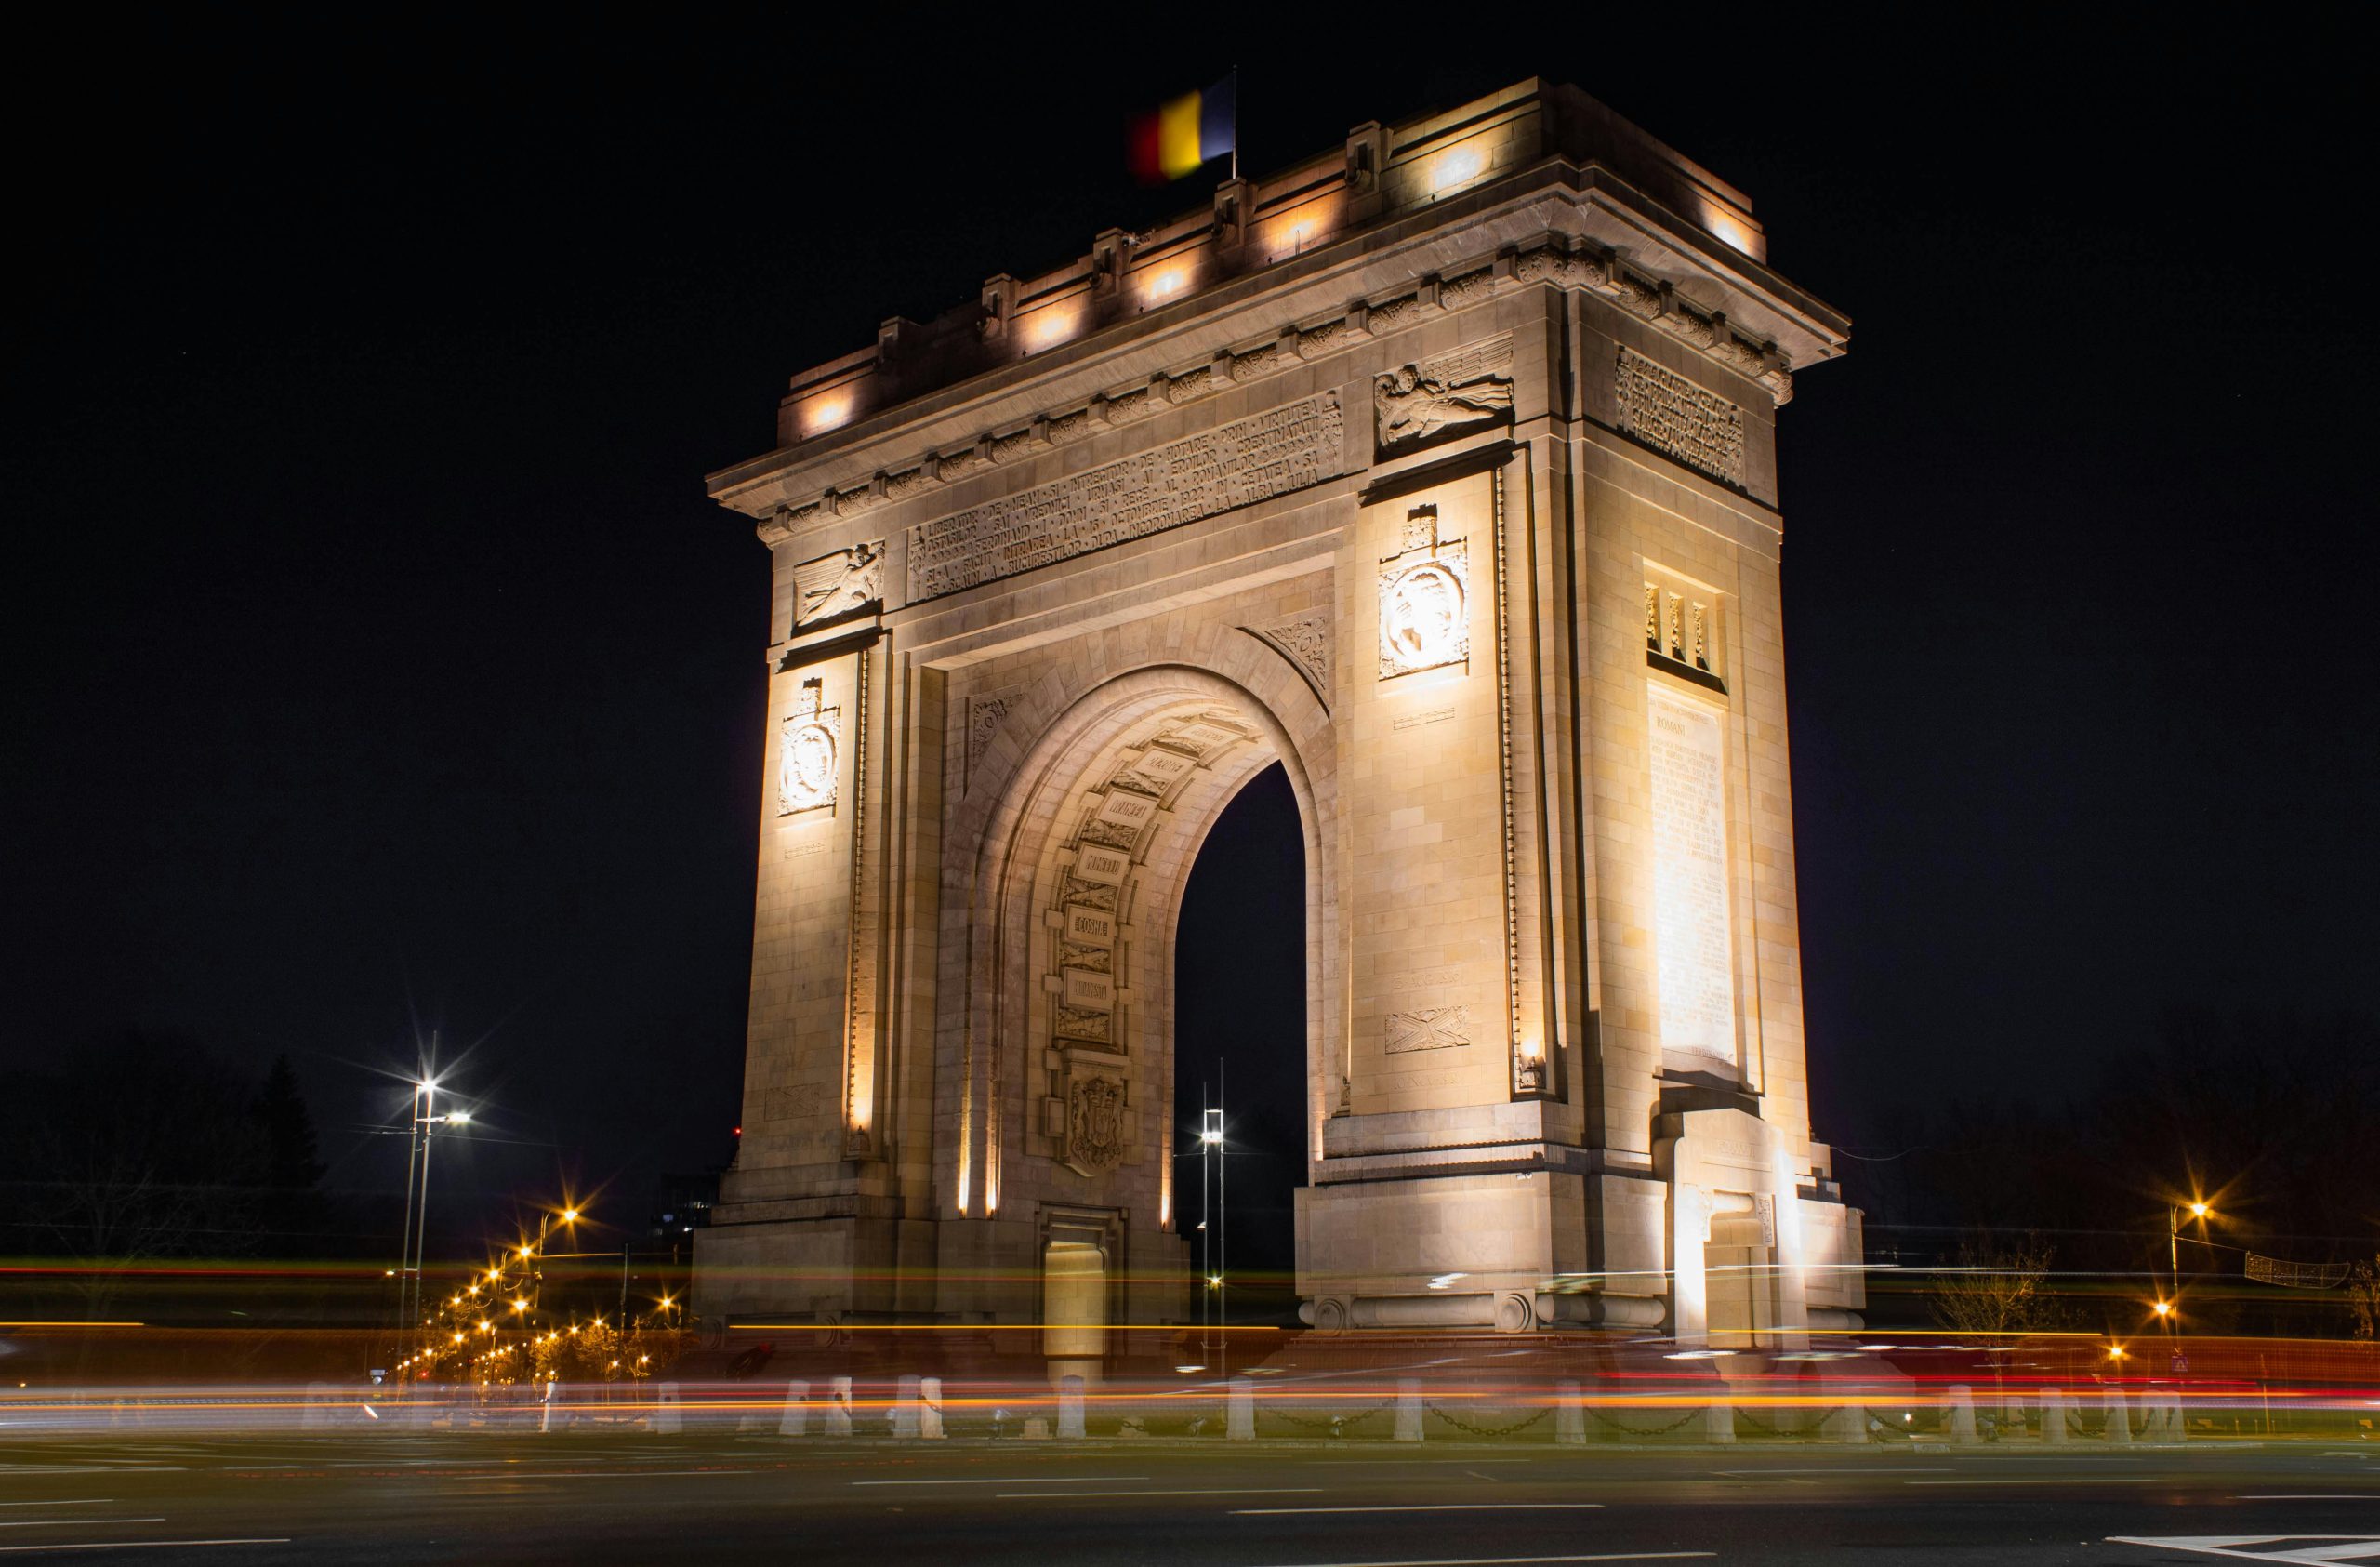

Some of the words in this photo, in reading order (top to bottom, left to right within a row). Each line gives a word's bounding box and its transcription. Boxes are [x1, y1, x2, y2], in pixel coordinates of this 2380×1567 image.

[988, 500, 1001, 519] DE
[1139, 451, 1153, 471] DE
[1220, 421, 1246, 445] PRIN
[1259, 398, 1317, 432] VIRTUTEA
[1025, 495, 1069, 523] VREDNICI
[1171, 447, 1216, 477] EROILOR
[1064, 524, 1078, 542] LA
[1111, 496, 1168, 528] OCTOMBRIE
[1180, 485, 1204, 507] 1922
[1216, 478, 1227, 497] IN
[1241, 458, 1290, 488] CETATEA
[1302, 450, 1318, 471] SA
[948, 569, 979, 592] SCAUN
[1214, 494, 1230, 514] LA
